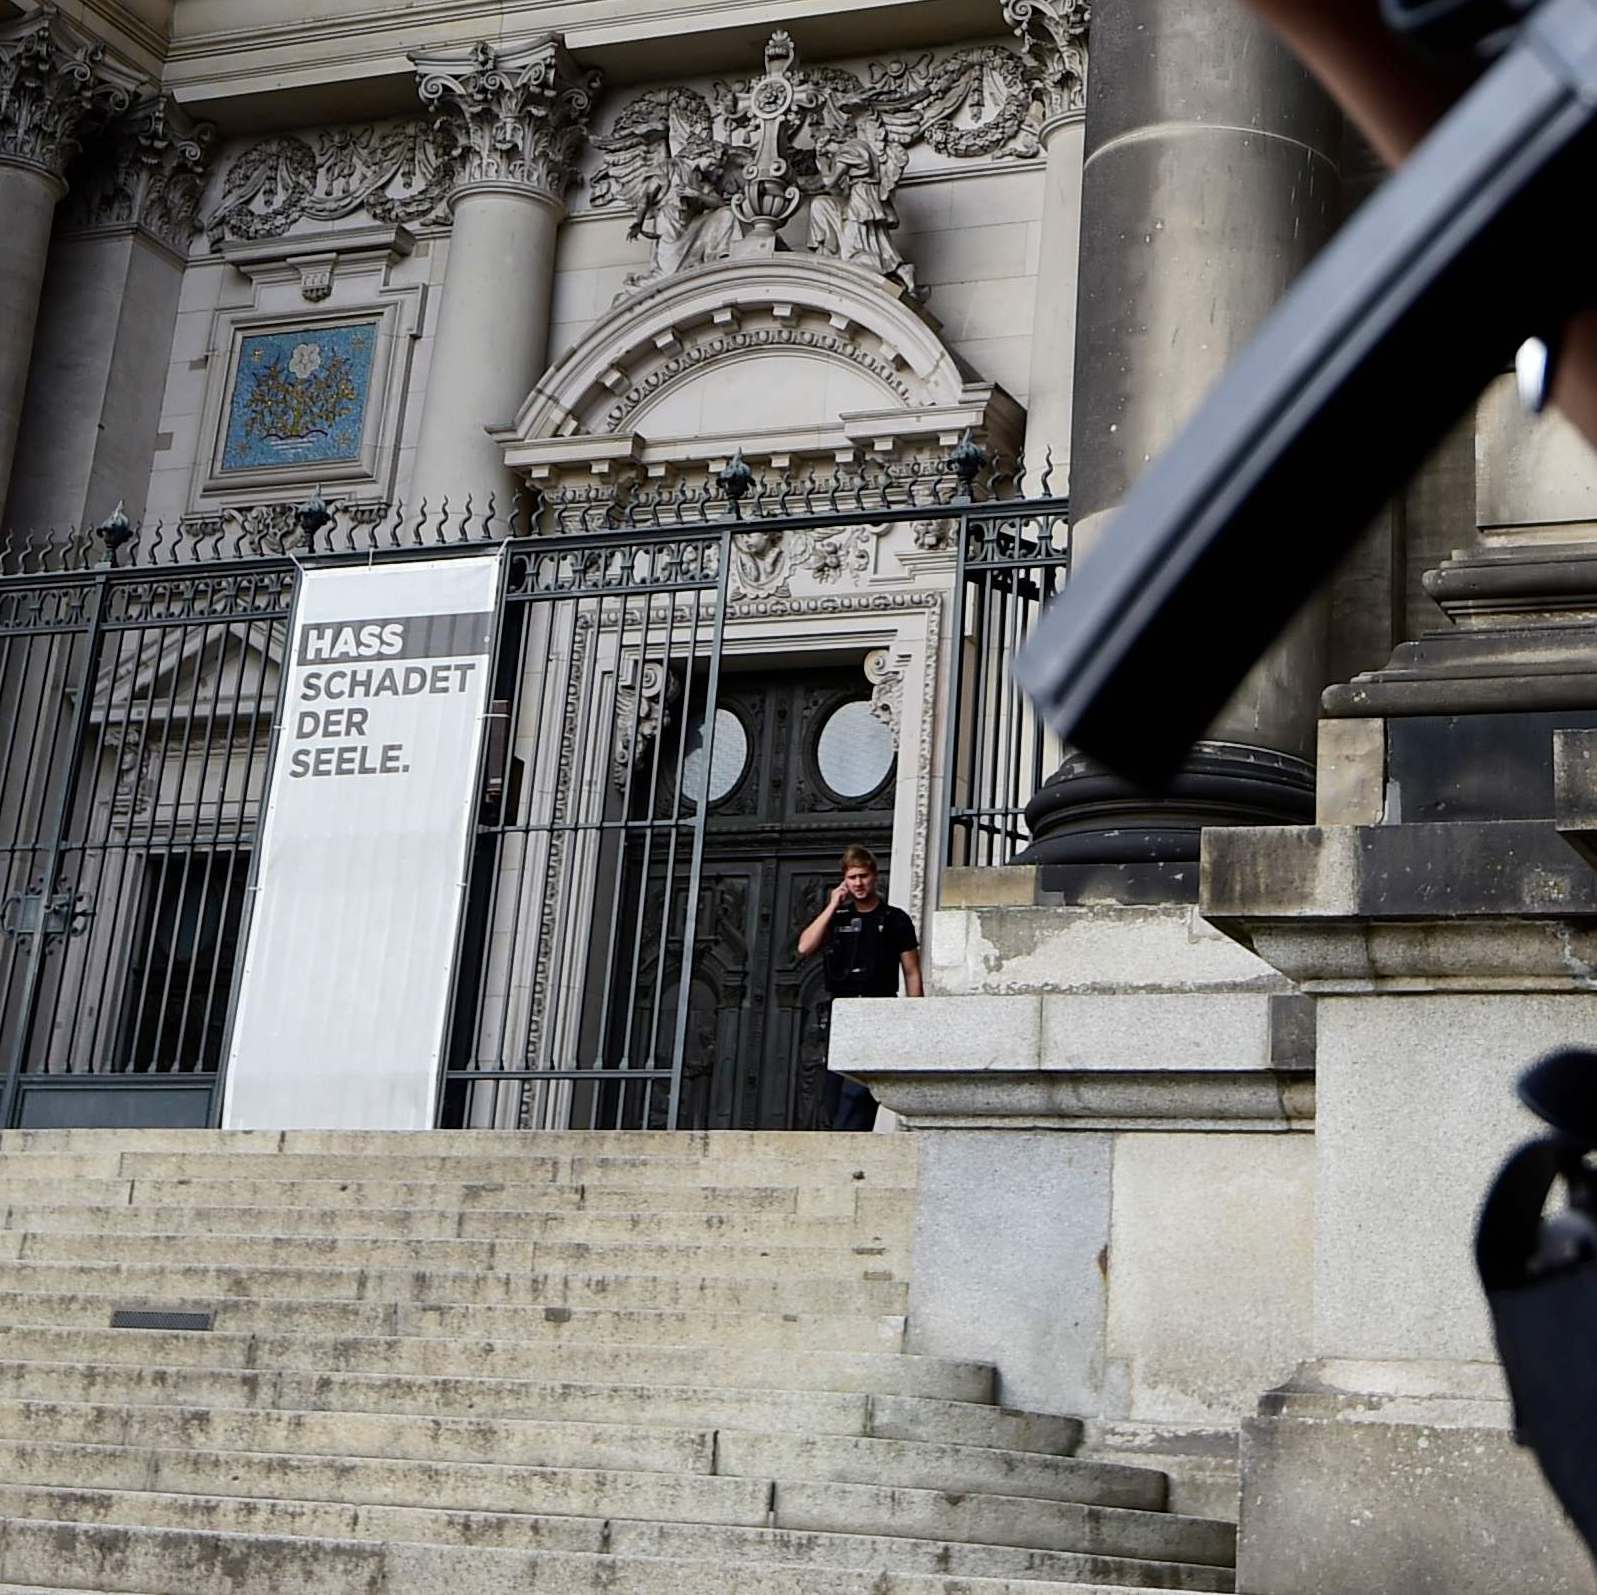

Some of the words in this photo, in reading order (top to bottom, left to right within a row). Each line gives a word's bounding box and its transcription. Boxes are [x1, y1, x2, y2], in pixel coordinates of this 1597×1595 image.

[306, 623, 404, 660] HASS
[300, 663, 476, 701] SCHADET
[296, 707, 369, 739] DER
[289, 744, 410, 778] SEELE.
